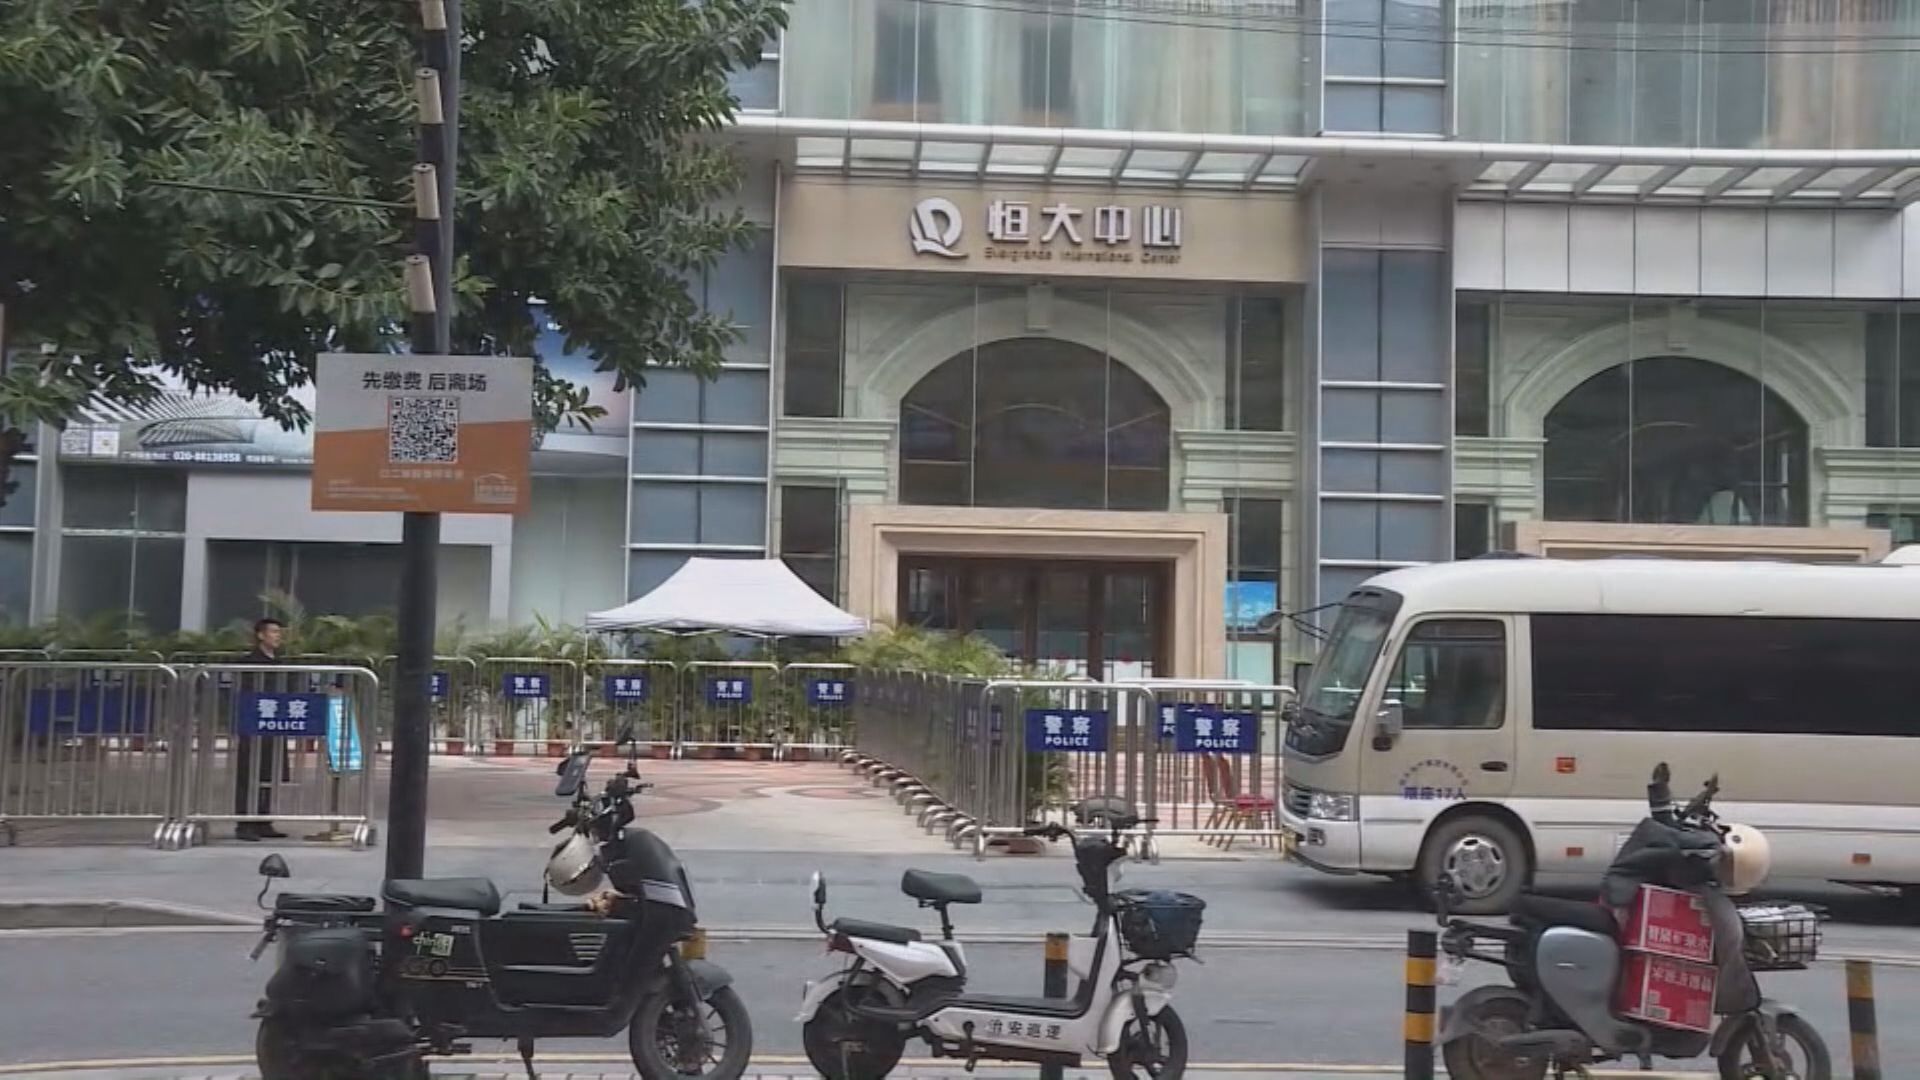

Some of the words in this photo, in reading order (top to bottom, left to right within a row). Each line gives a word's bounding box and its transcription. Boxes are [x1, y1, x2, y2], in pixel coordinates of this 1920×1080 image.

[987, 200, 1182, 247] 恒大中心
[363, 371, 422, 390] 先缴费
[428, 373, 487, 392] 后离场
[258, 699, 308, 718] 警察
[258, 721, 306, 730] POLICE
[1045, 715, 1090, 734] 警察
[1195, 718, 1240, 736] 警察
[1045, 736, 1088, 746] POLICE
[1195, 739, 1238, 748] POLICE
